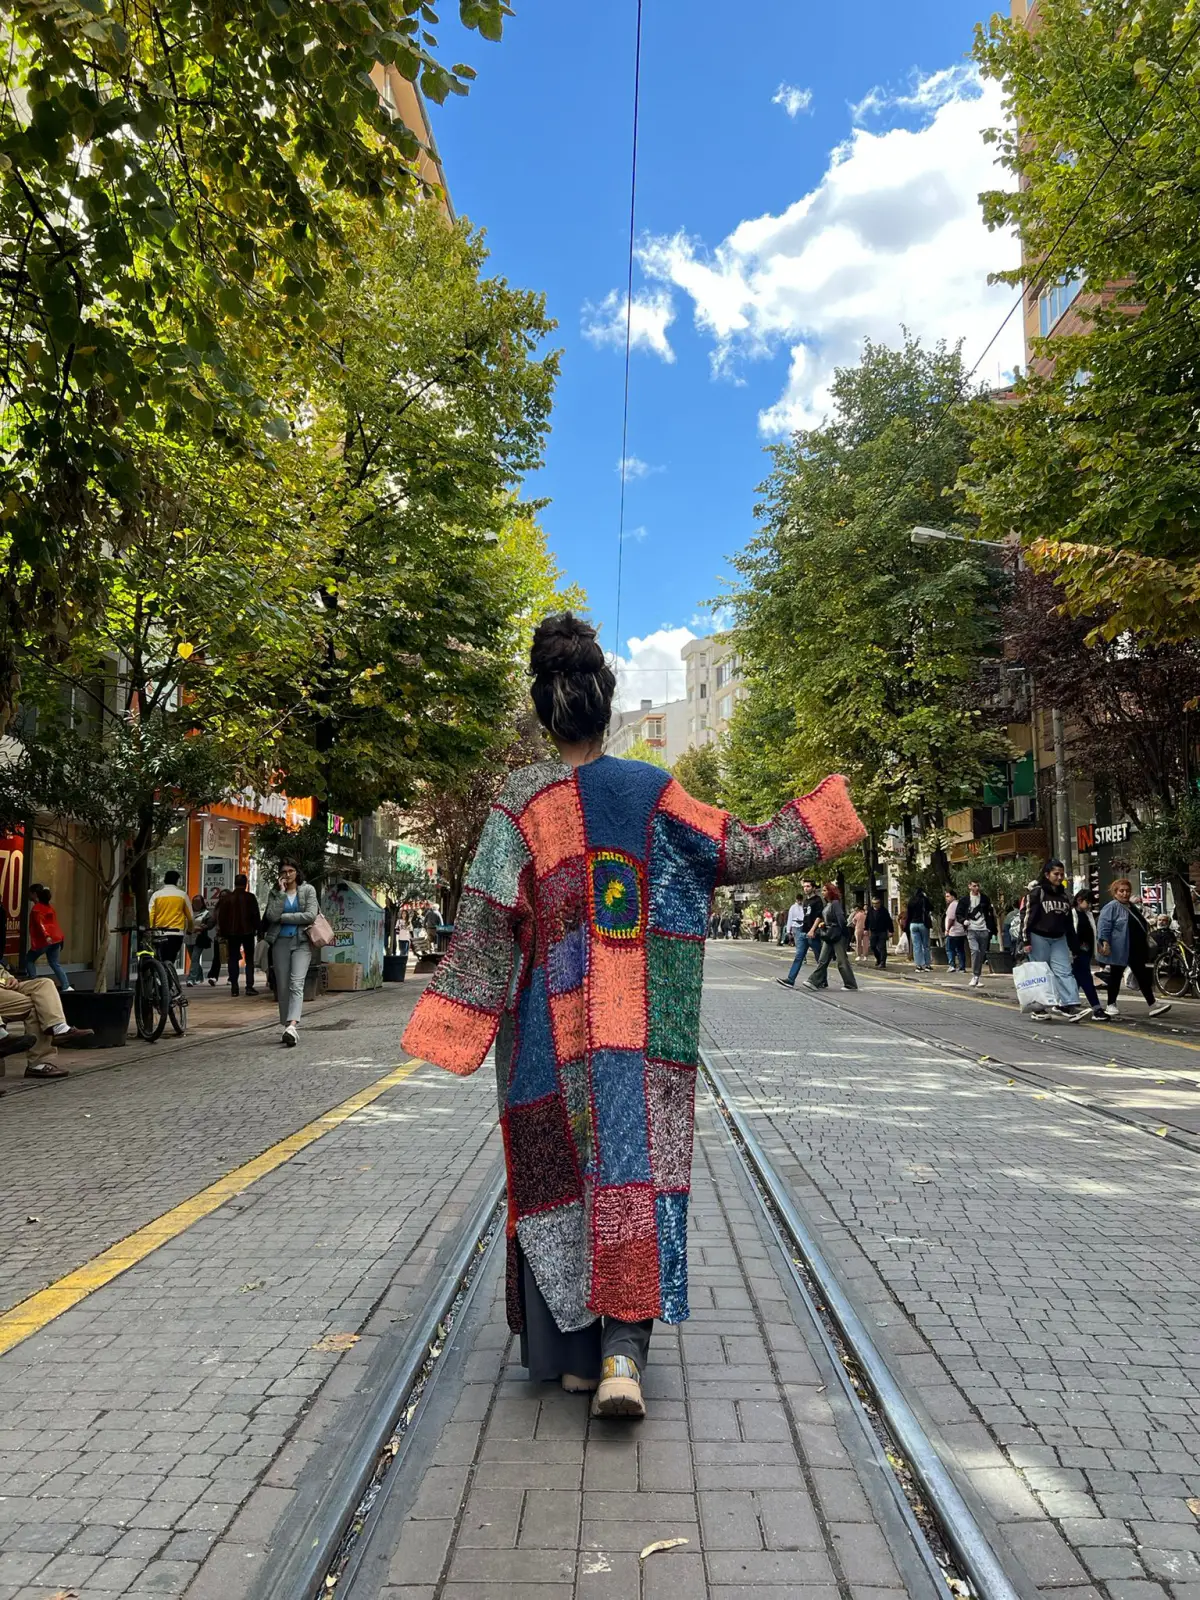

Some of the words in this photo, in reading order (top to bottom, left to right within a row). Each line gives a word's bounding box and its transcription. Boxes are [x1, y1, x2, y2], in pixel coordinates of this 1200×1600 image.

[1077, 824, 1094, 852] IN
[1095, 822, 1128, 844] STREET
[0, 849, 24, 918] 70
